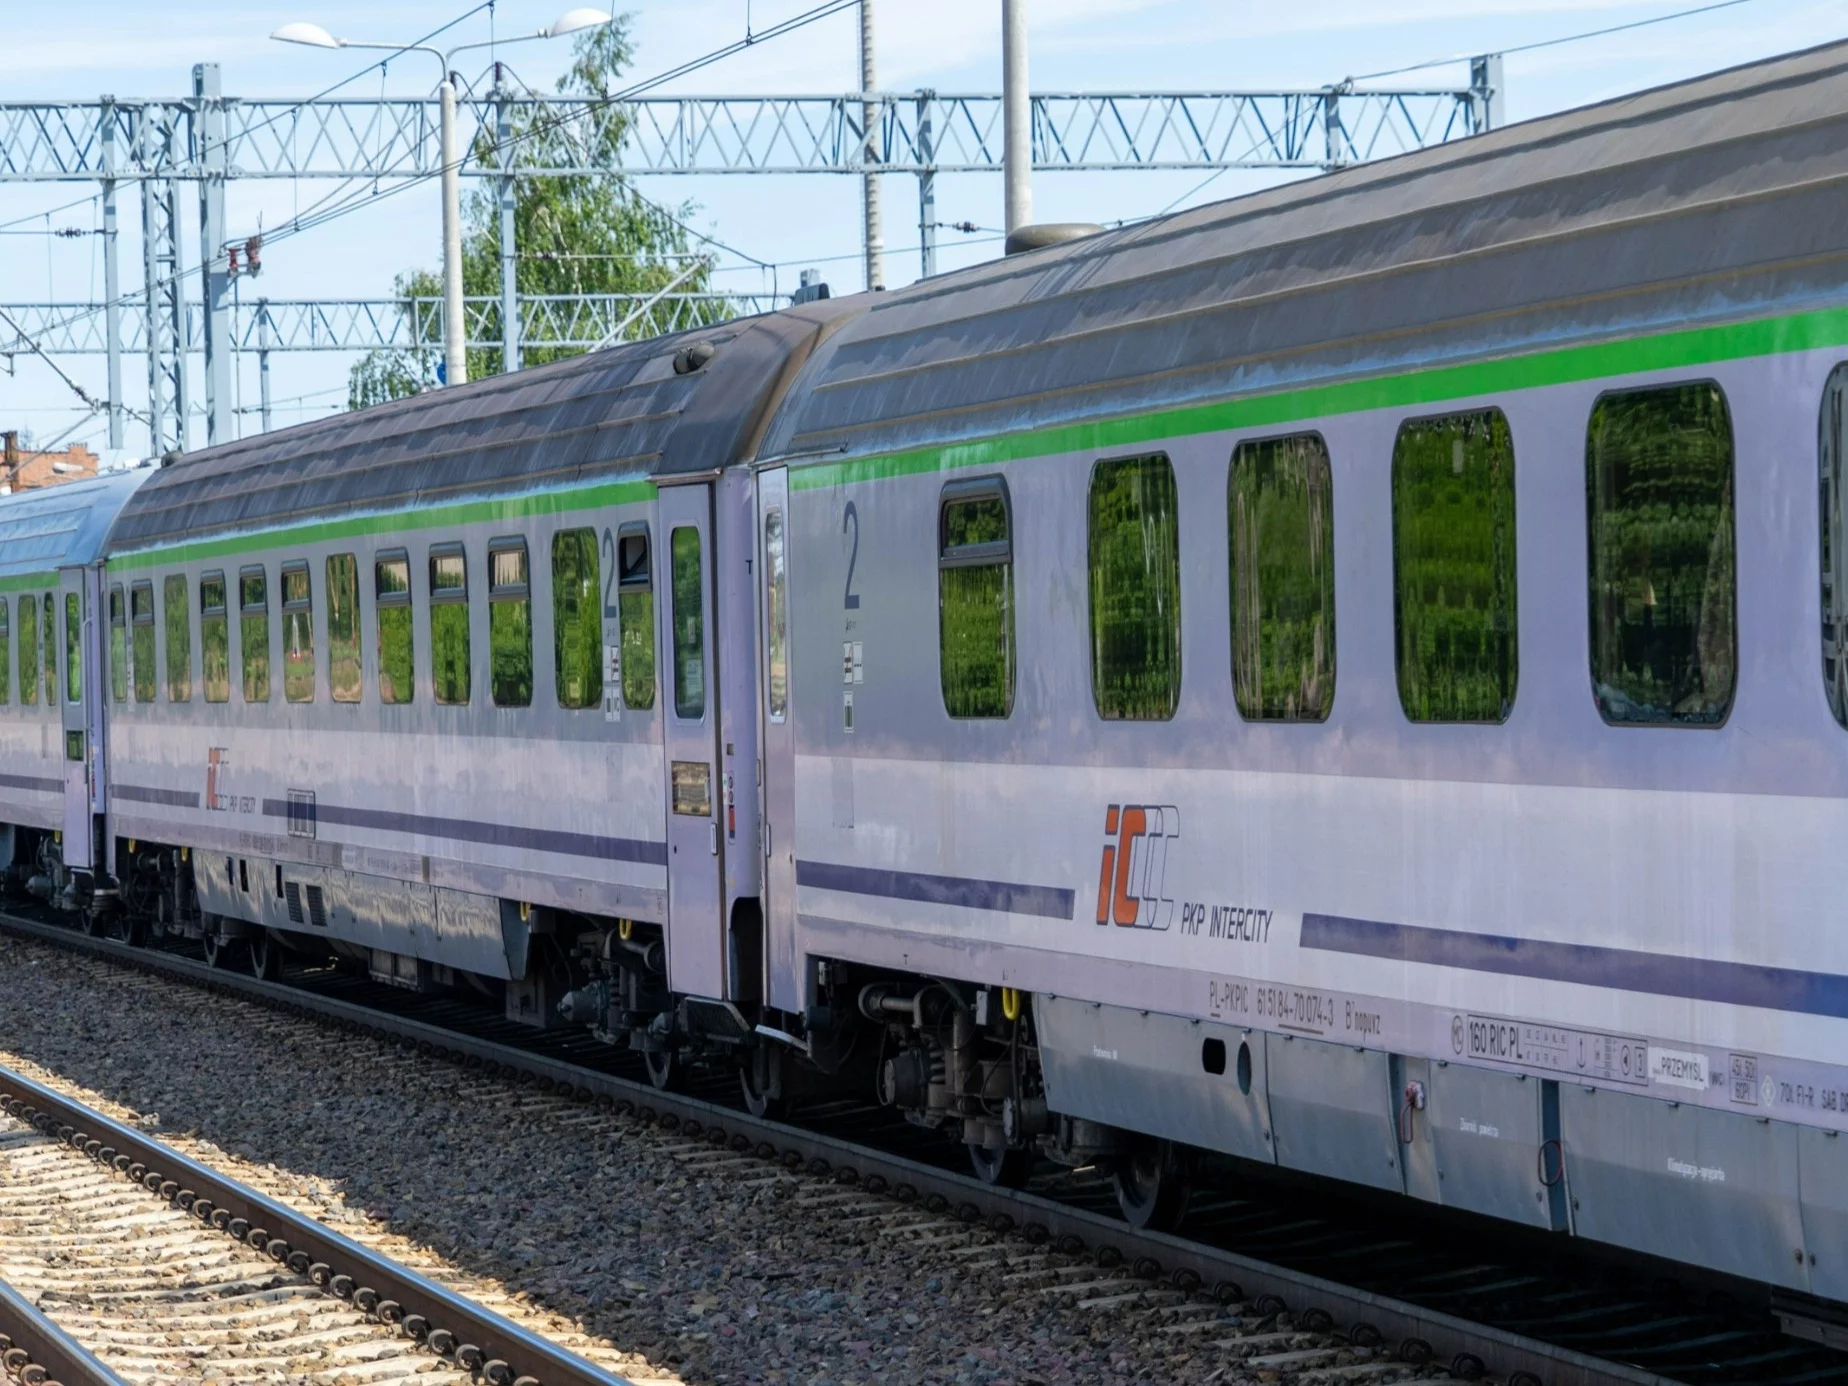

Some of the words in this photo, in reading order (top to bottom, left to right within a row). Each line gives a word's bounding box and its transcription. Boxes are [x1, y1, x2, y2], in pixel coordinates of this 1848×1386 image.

[602, 527, 617, 618] 2
[844, 500, 859, 610] 2
[1181, 902, 1206, 936] PKP
[1209, 905, 1274, 944] INTERCITY
[1209, 980, 1249, 1013] PL-PKPIC
[1469, 1021, 1486, 1053] 160
[1490, 1023, 1507, 1056] RIC
[1509, 1026, 1523, 1059] PL
